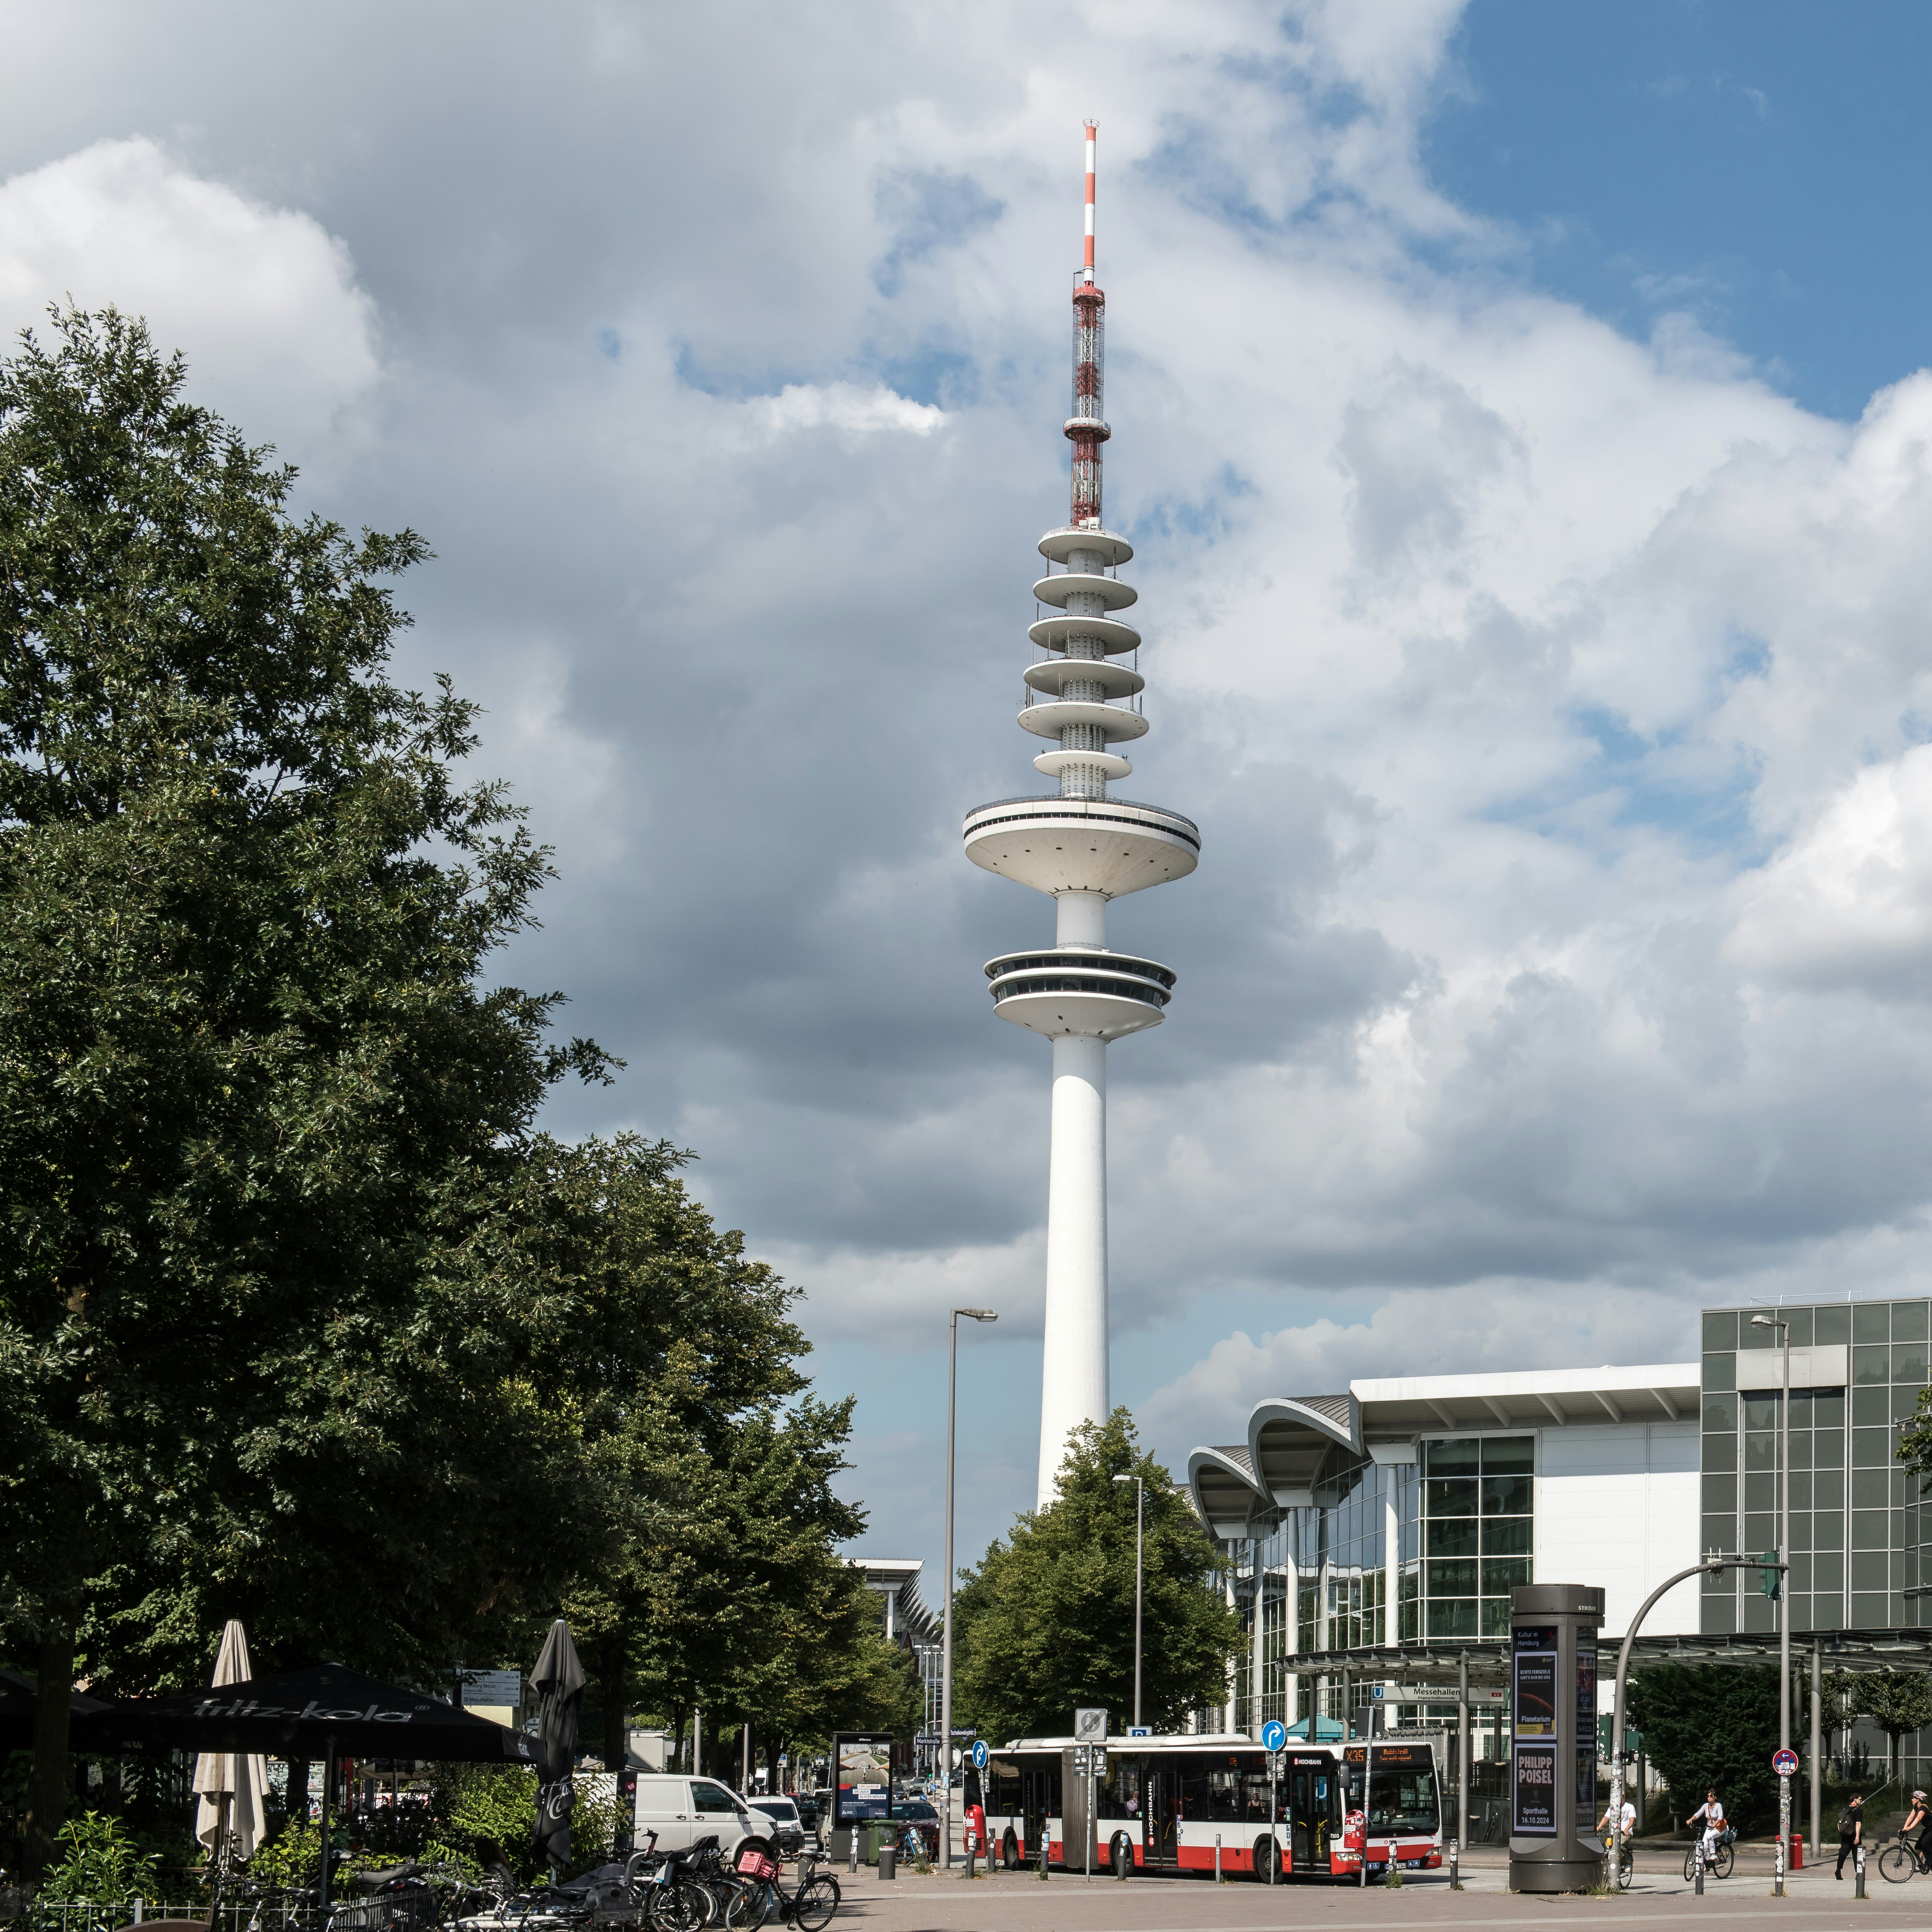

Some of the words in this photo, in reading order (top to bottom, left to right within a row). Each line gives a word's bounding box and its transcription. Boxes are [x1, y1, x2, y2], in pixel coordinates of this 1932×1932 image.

[1374, 1688, 1382, 1698] U
[194, 1698, 413, 1722] fritz-kola
[1346, 1750, 1364, 1761] X35
[1518, 1756, 1552, 1769] PHILIPP
[1519, 1769, 1552, 1784] POISEL
